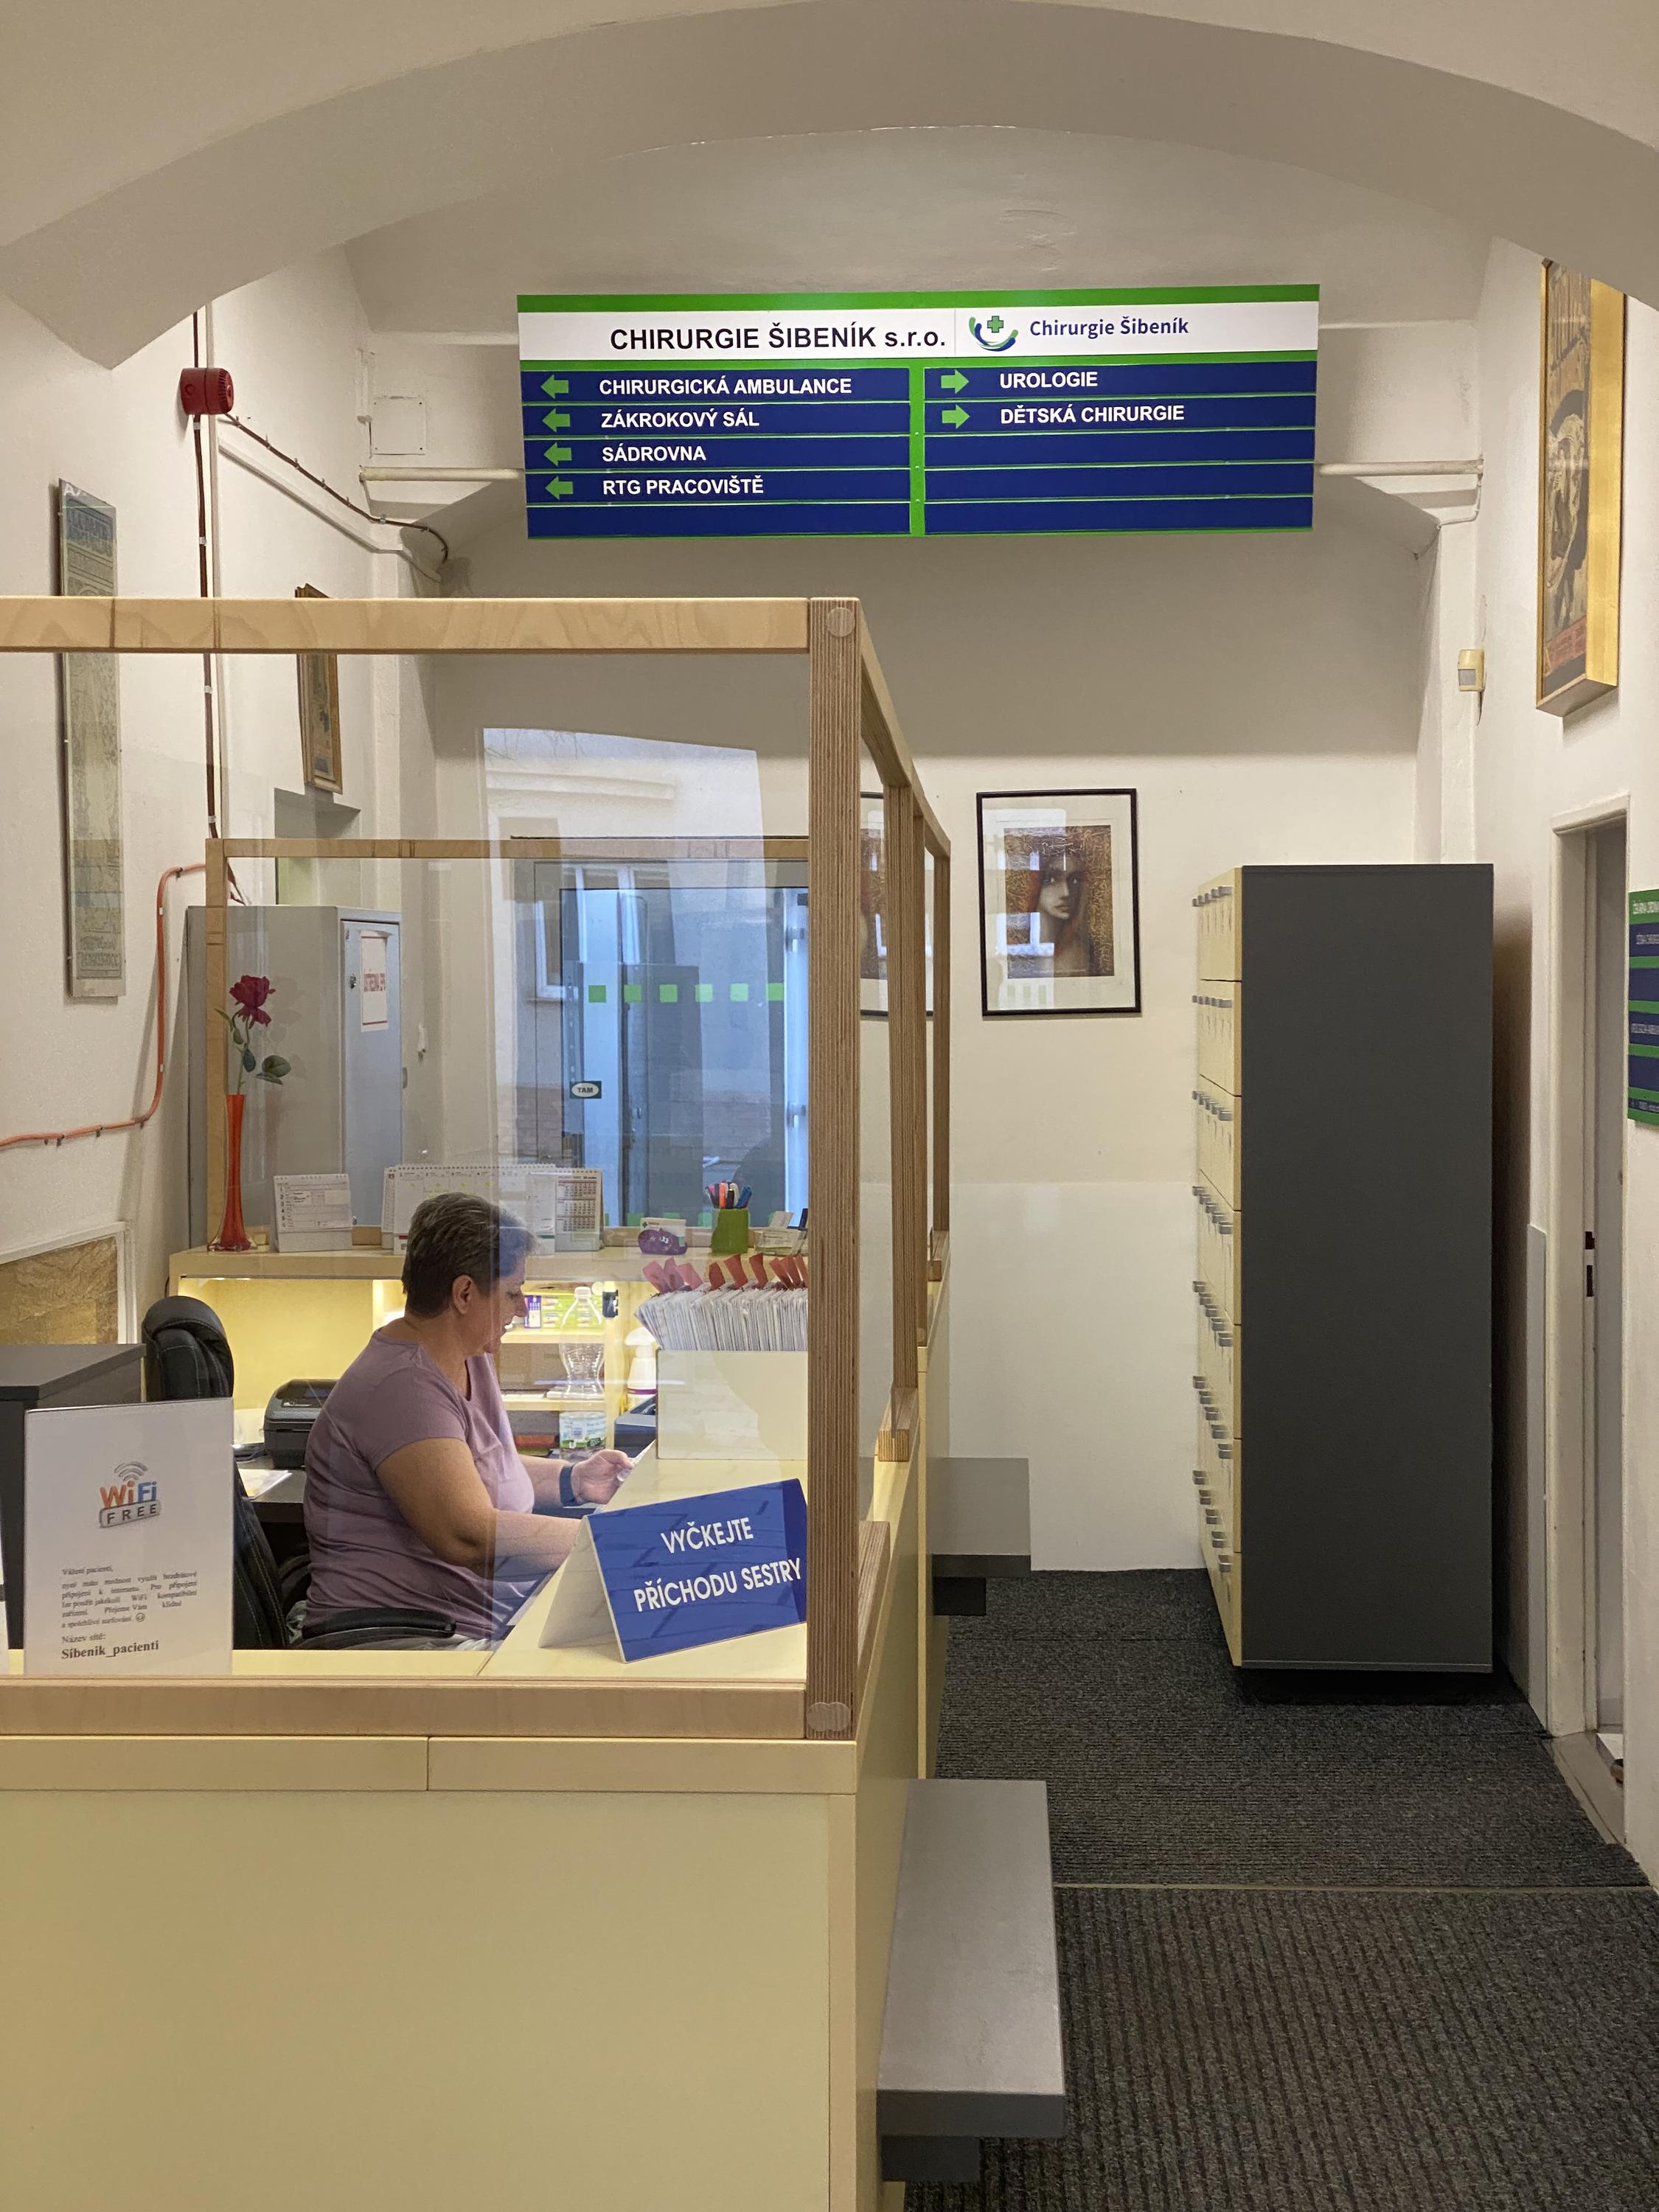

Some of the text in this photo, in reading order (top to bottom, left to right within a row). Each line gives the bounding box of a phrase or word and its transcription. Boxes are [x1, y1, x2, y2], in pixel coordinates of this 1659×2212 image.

[611, 322, 945, 350] CHIRURGIE ŠIBENÍK s.r.o.
[1029, 316, 1189, 339] Chirurgie Šibeník
[599, 375, 852, 395] CHIRURGICKÁ AMBULANCE
[999, 371, 1099, 389] UROLOGIE
[601, 407, 759, 428] ZÁKROKOVÝ SÁL
[1001, 404, 1185, 424] DĚTSKÁ CHIRURGIE
[602, 443, 706, 462] SÁDROVNA
[602, 475, 765, 495] RTG PRACOVIŠTĚ
[100, 1480, 158, 1509] WiFi
[107, 1503, 157, 1525] FREE
[661, 1517, 754, 1554] VYČKEJTE
[633, 1557, 801, 1613] PŘÍCHODU SESTRY
